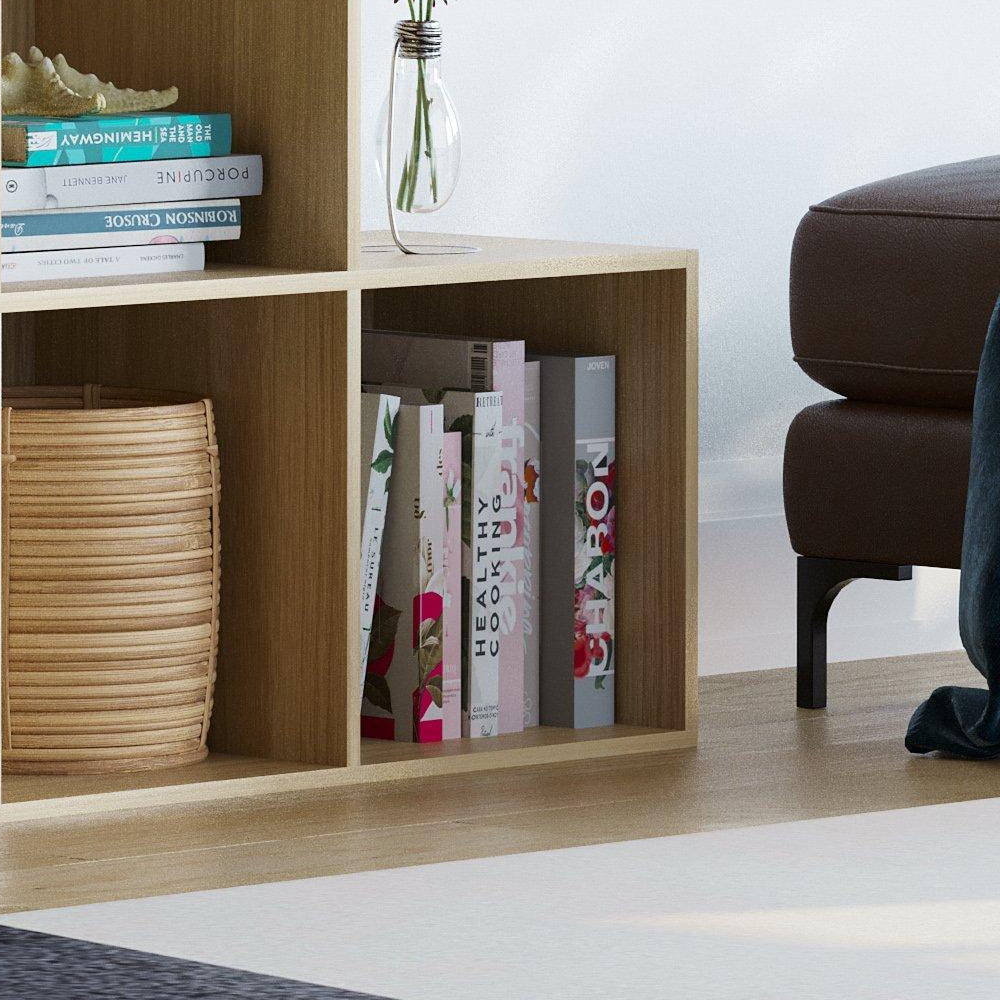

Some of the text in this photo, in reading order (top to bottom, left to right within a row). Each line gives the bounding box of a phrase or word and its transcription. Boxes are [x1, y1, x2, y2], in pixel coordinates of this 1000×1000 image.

[60, 130, 153, 146] HEMINGWAY
[159, 127, 167, 143] SEA
[169, 126, 177, 143] THE
[195, 124, 203, 142] OLD
[204, 124, 212, 142] THE
[62, 174, 128, 187] JANE BENNETT
[156, 167, 249, 184] PORCUPINE
[105, 210, 238, 228] ROBINSON CRUSOE
[475, 497, 489, 657] HEALTHY
[489, 494, 502, 659] COOKING
